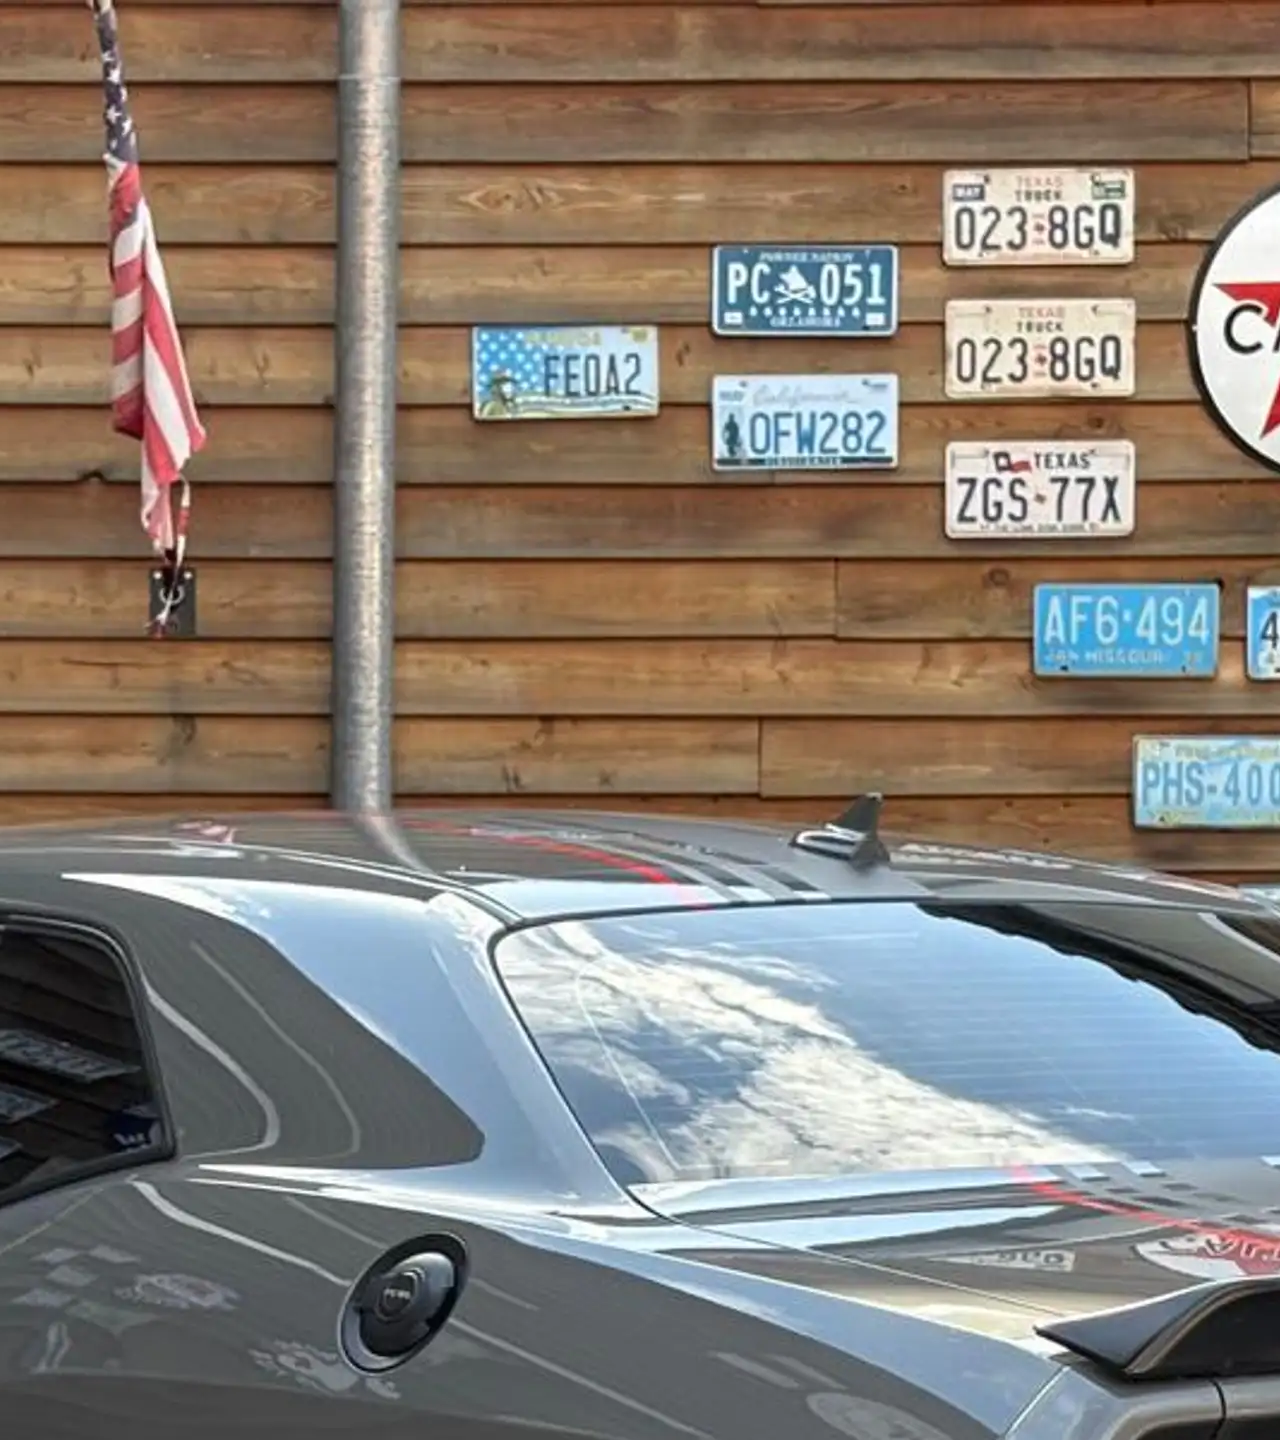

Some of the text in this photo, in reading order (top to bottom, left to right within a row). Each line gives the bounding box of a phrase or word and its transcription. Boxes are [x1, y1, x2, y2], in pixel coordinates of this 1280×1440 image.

[955, 203, 1121, 250] 023 8GQ
[727, 262, 886, 305] PC 051
[956, 334, 1121, 383] 023 8GQ
[1034, 453, 1090, 470] TEXAS
[957, 476, 1121, 523] ZGS 77X
